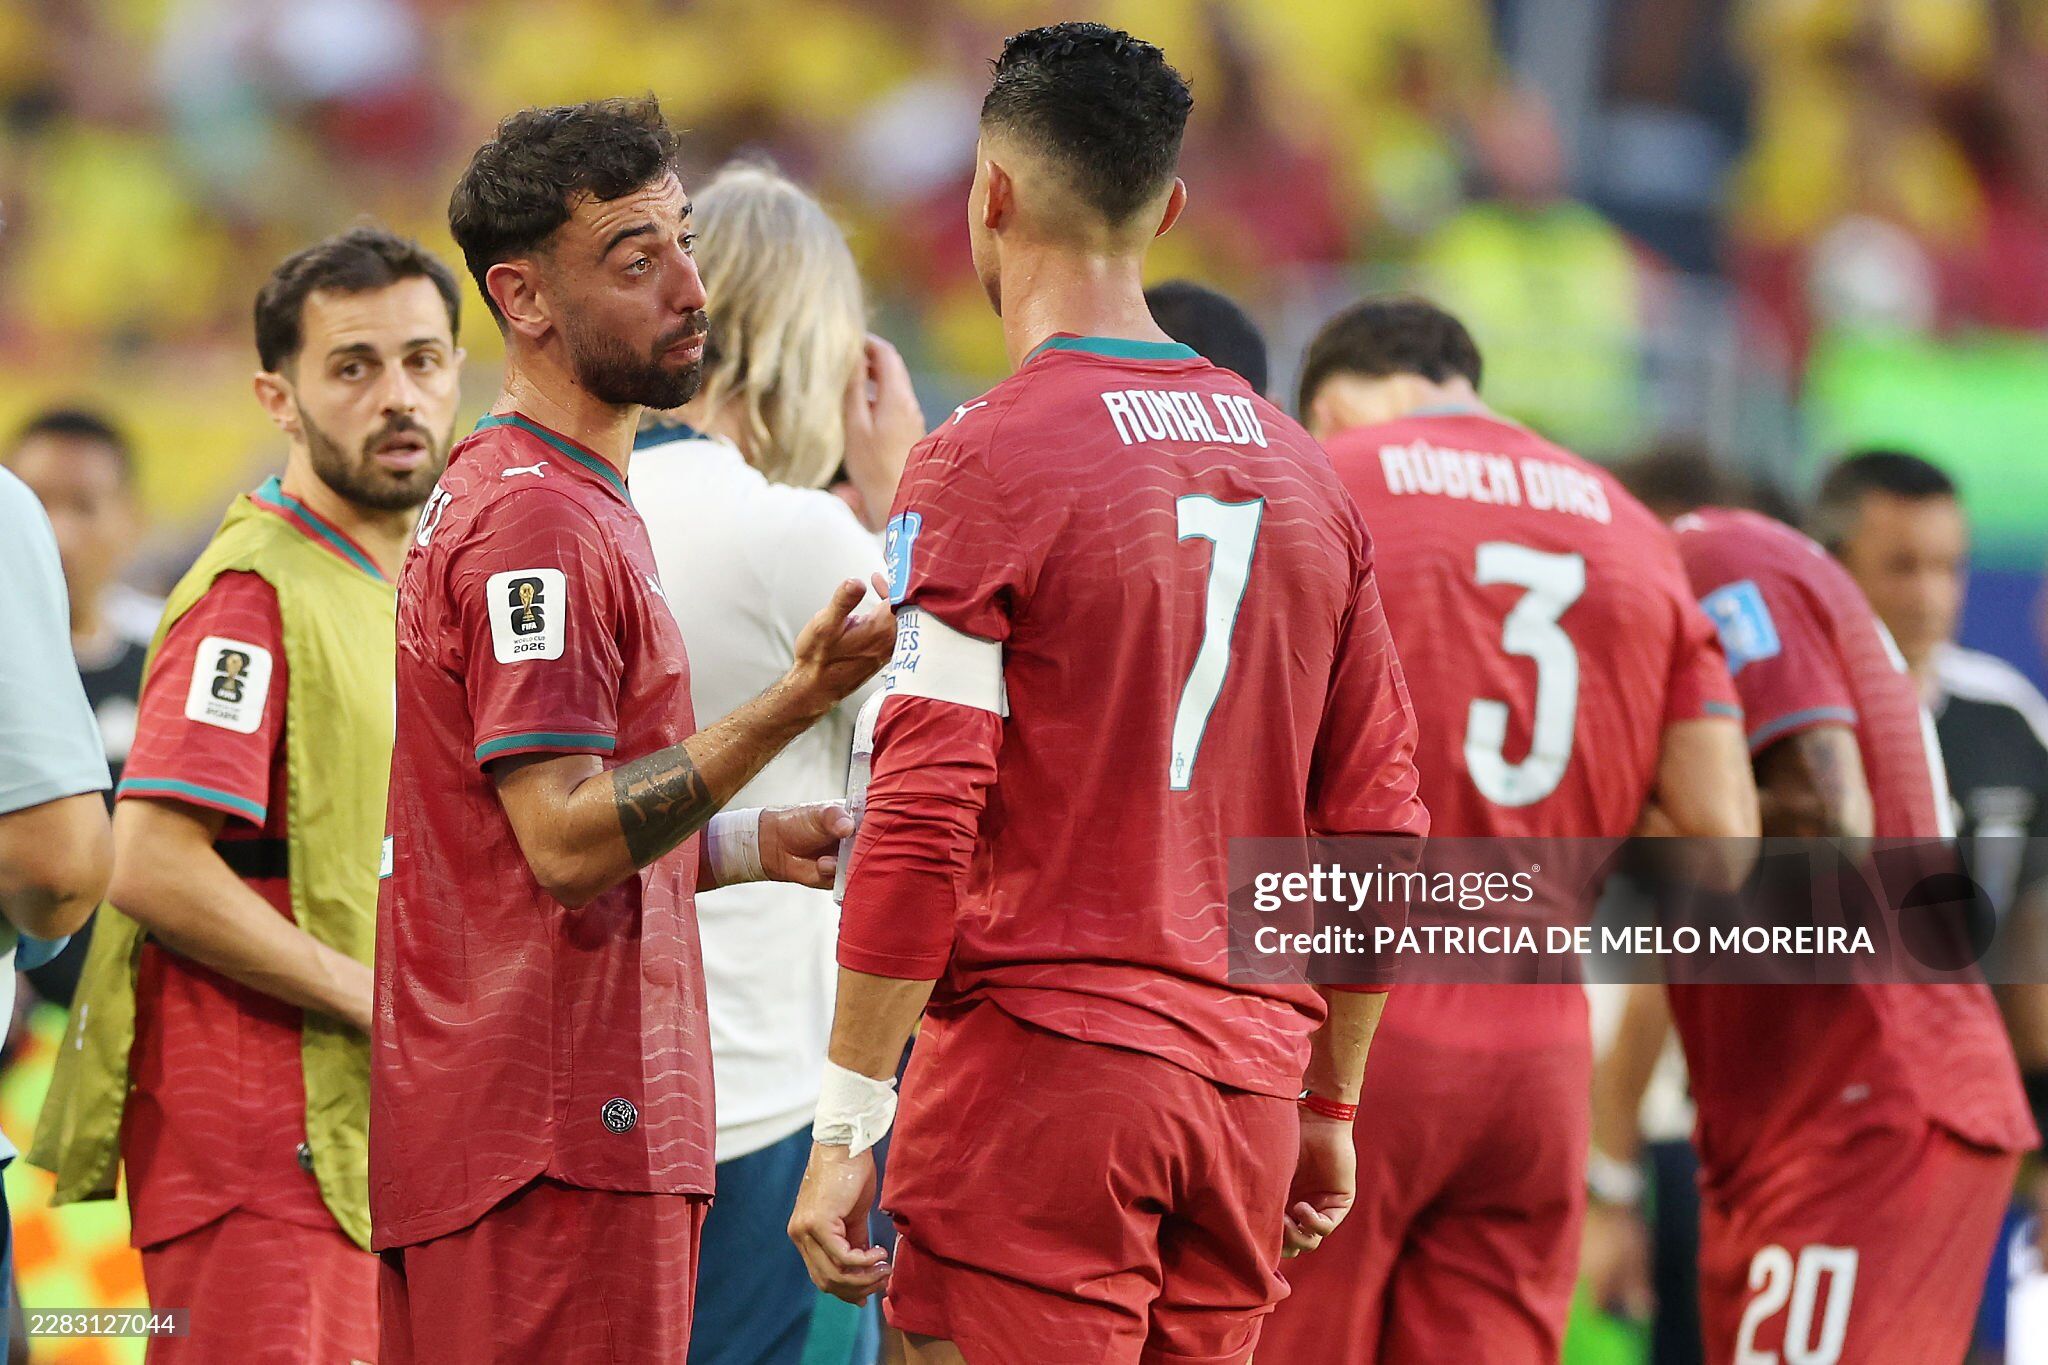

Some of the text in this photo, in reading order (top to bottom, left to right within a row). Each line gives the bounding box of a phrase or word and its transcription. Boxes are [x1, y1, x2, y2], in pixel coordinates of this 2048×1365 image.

[1101, 389, 1268, 449] RONALDO
[1380, 438, 1613, 525] RÚBEN DIAS
[513, 642, 546, 654] 2026
[521, 621, 537, 632] FIFA
[1169, 494, 1265, 791] 7
[1464, 540, 1586, 807] 3
[1732, 1243, 1859, 1365] 20
